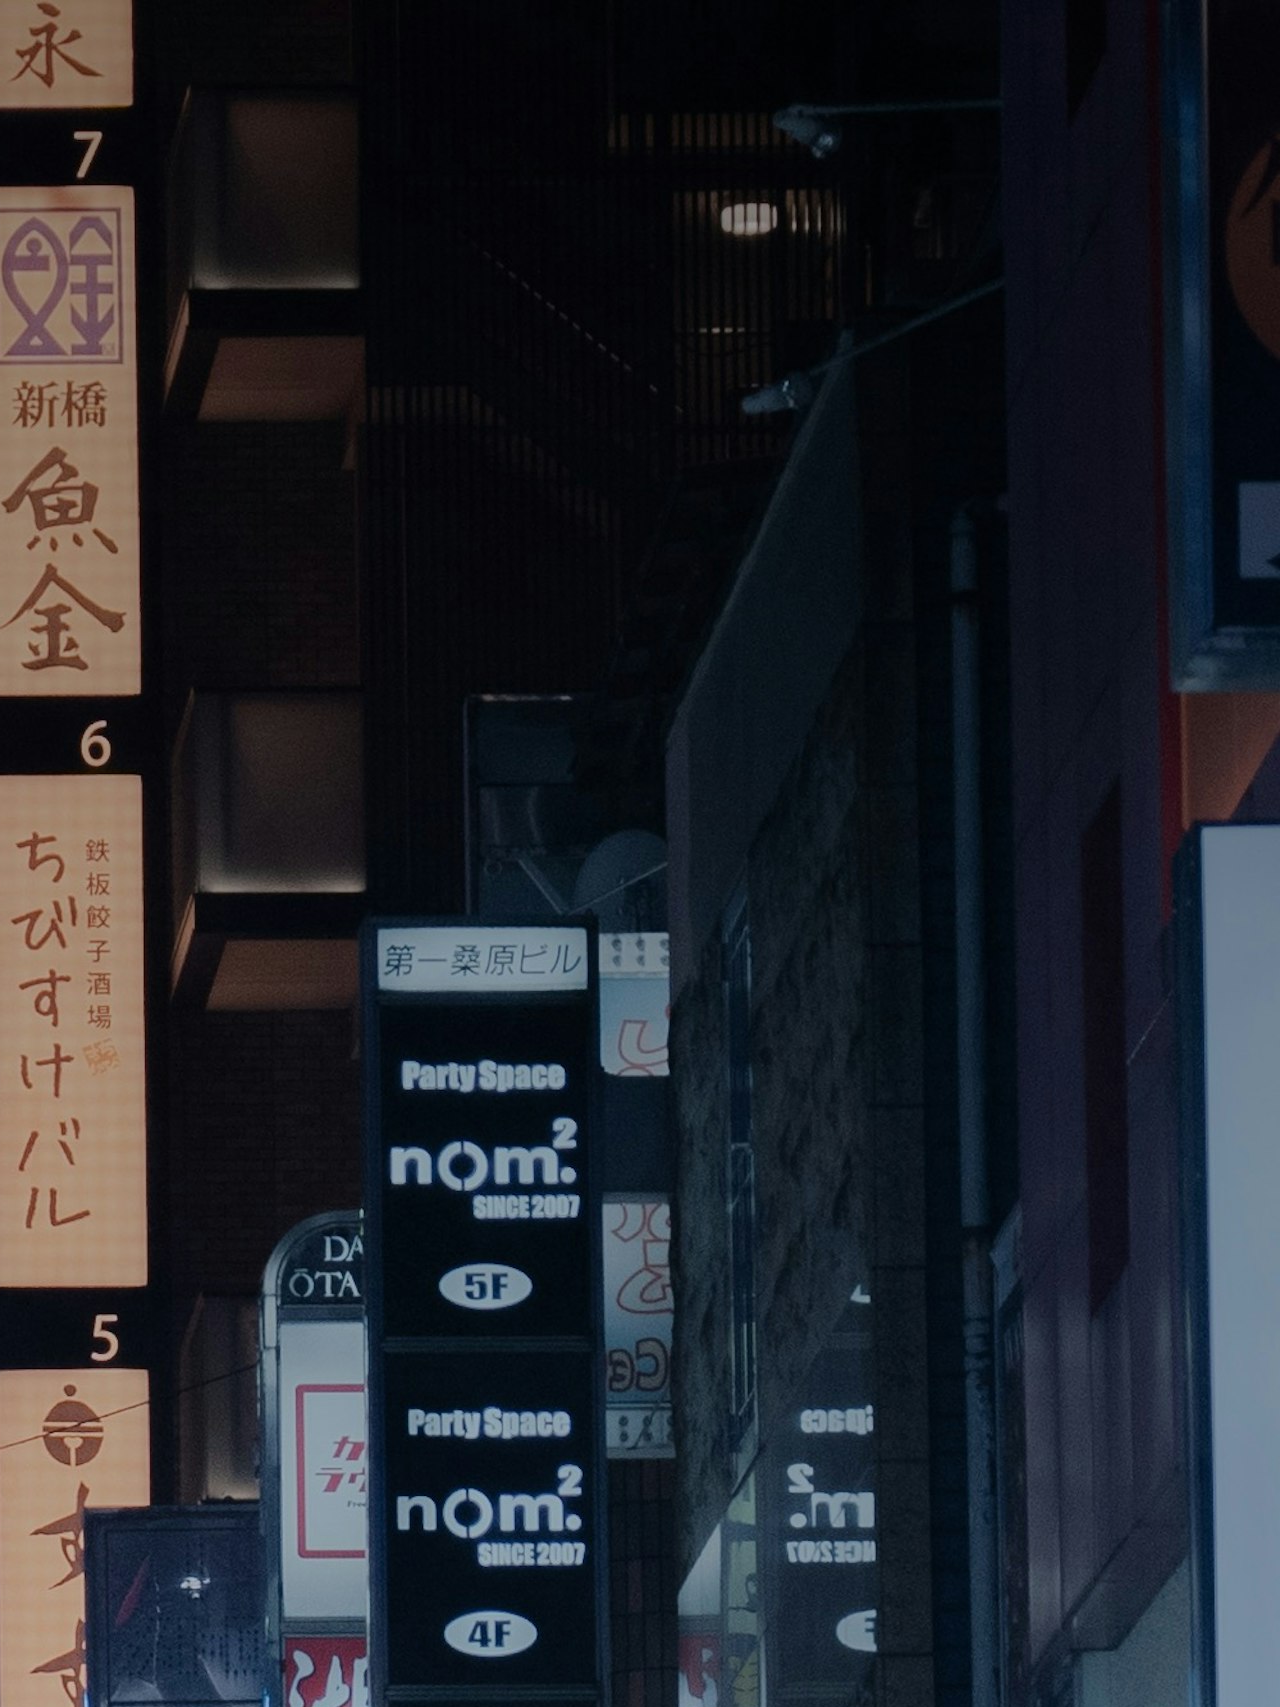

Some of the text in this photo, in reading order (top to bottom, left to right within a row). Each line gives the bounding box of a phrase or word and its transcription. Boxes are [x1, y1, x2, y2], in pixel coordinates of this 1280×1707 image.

[72, 130, 104, 179] 7
[11, 379, 108, 430] 新橋
[0, 445, 126, 672] 魚金
[80, 718, 112, 768] 6
[84, 836, 113, 1030] 鉄板餃子酒場
[383, 942, 583, 978] 第一桑原ビル
[10, 831, 90, 1230] ちびすけバル
[401, 1058, 567, 1095] Party Space
[472, 1194, 582, 1220] SINCE 2007
[463, 1272, 510, 1300] 5F
[90, 1313, 119, 1362] 5
[407, 1405, 572, 1441] Party Space
[477, 1540, 586, 1567] SINCE 2007
[468, 1621, 512, 1648] 4F
